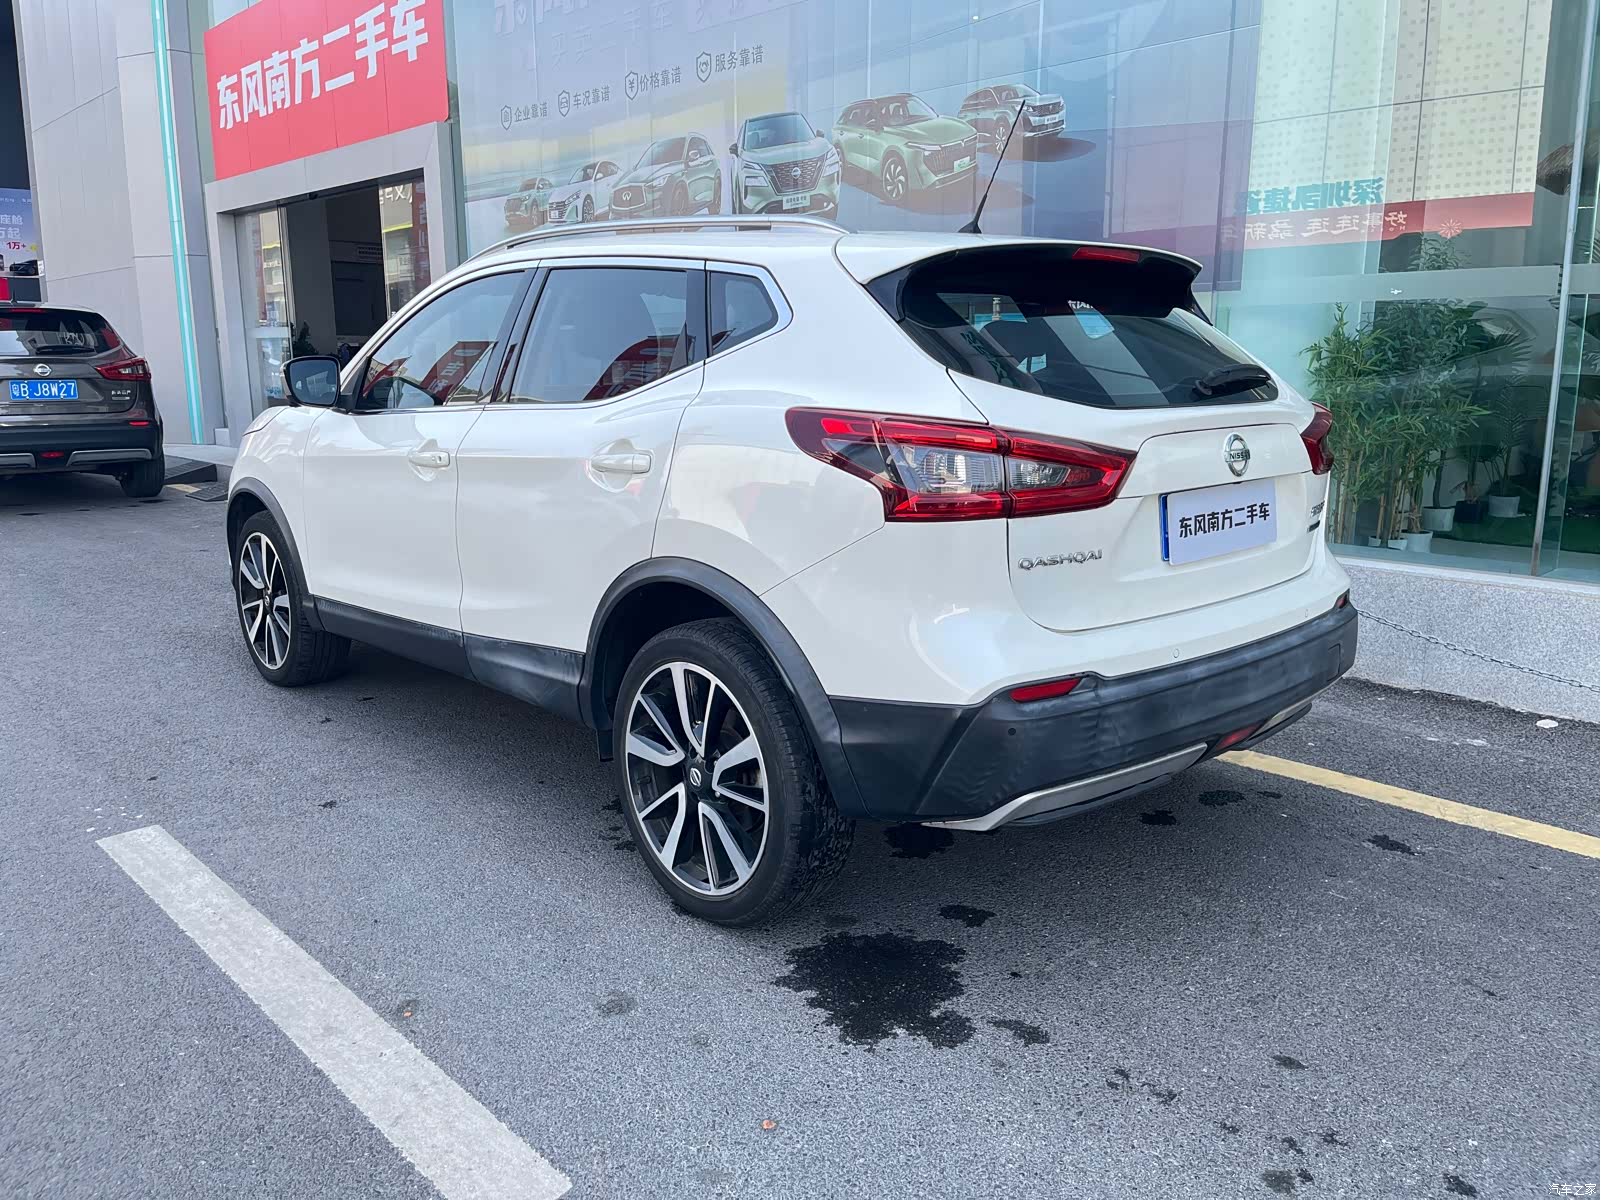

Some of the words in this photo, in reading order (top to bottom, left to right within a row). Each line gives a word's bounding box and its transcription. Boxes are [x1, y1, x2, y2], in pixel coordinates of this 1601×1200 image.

[217, 0, 428, 130] 东风南方二手车
[715, 44, 764, 72] 服务靠谱
[639, 66, 682, 92] 价格靠谱
[573, 86, 610, 109] 车况靠谱
[514, 102, 548, 122] 企业靠谱
[1179, 502, 1270, 538] 东风南方二手车
[1018, 549, 1102, 570] QASHQAI
